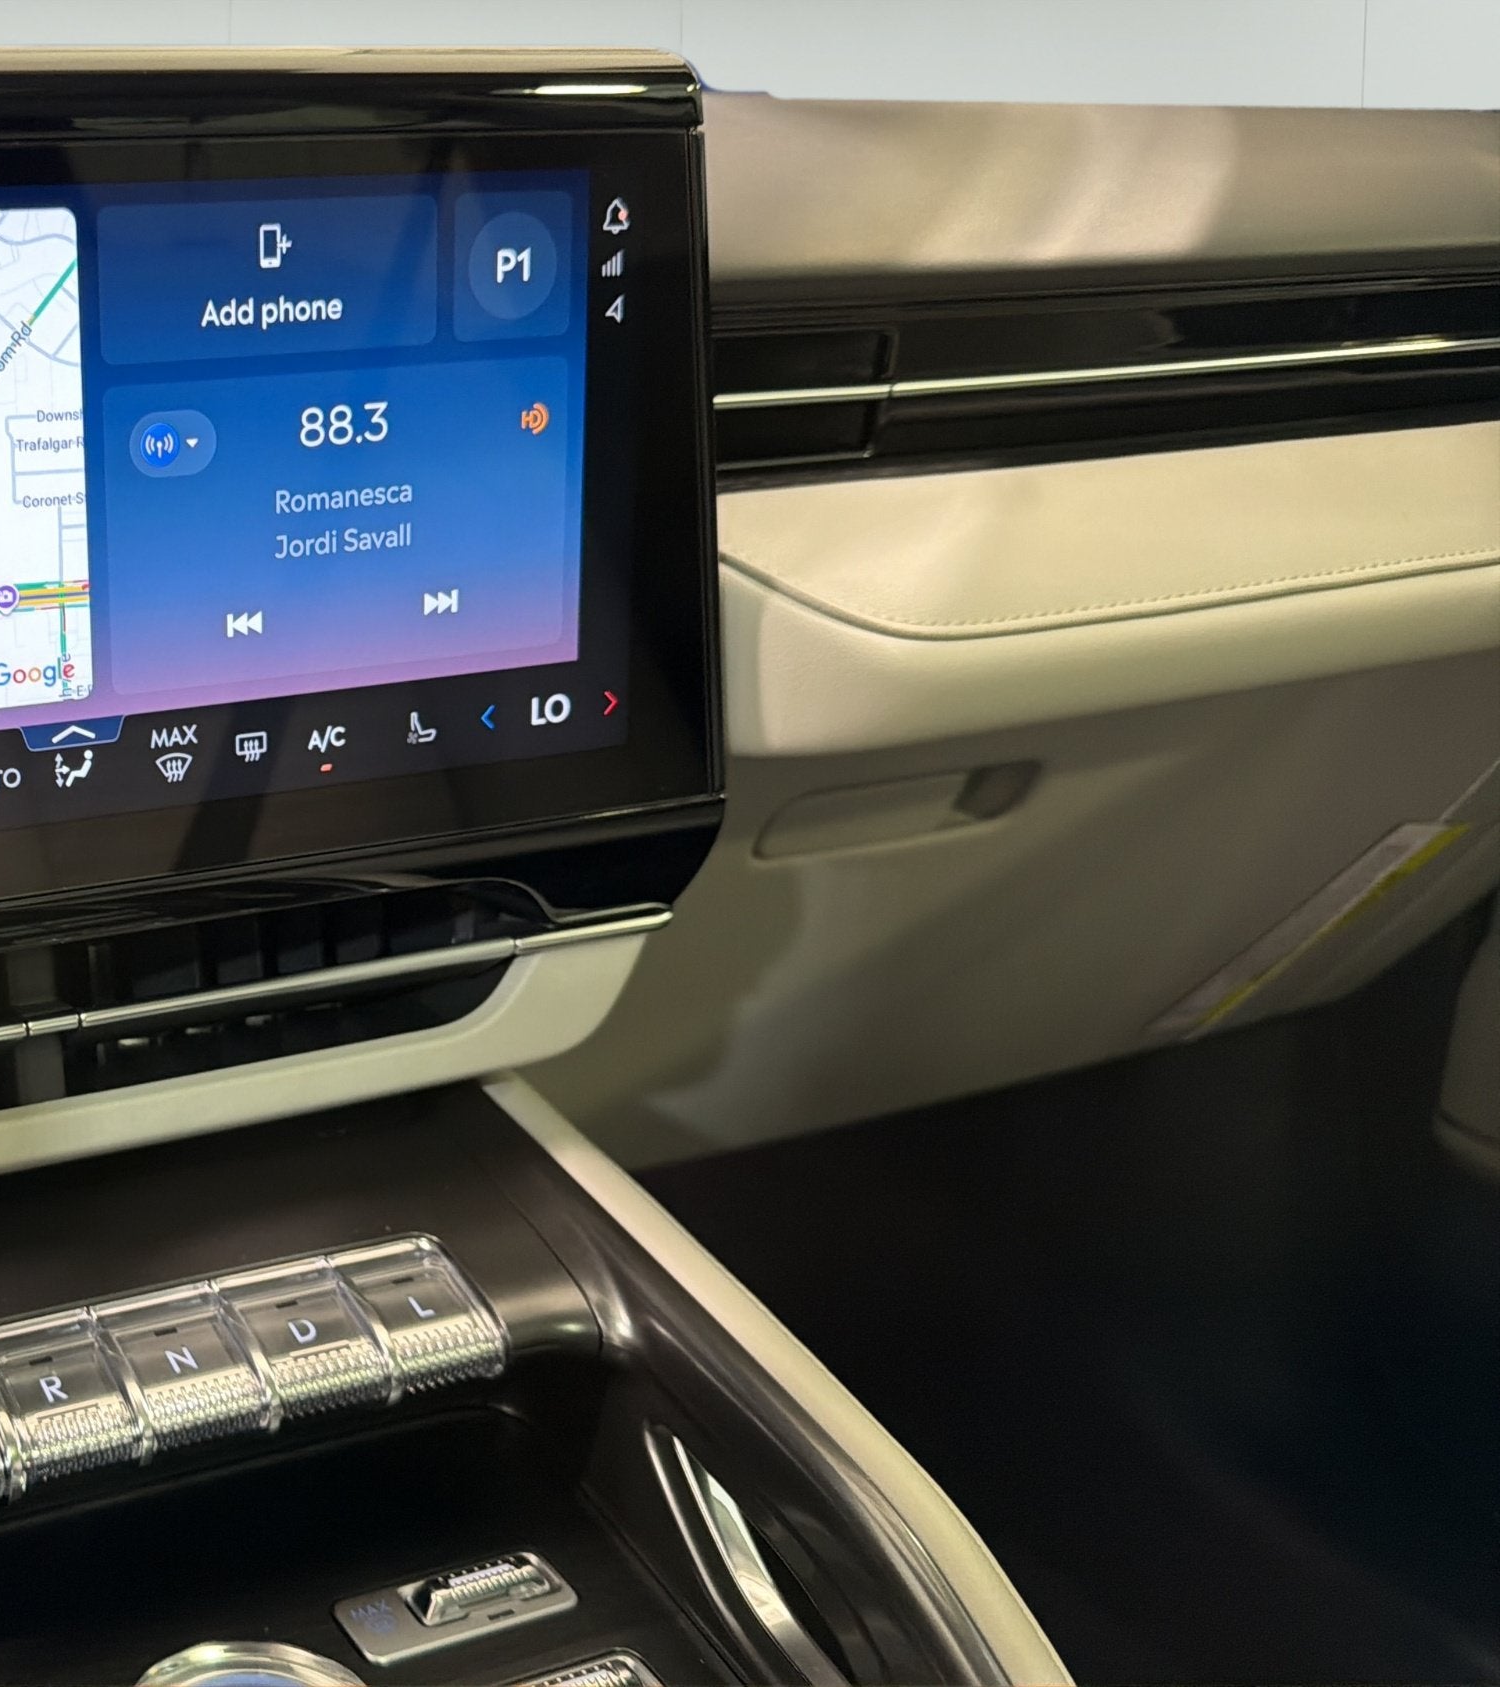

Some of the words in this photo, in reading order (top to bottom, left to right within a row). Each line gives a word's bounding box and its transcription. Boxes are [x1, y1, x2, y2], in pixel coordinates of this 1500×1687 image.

[497, 247, 532, 283] P1
[201, 297, 254, 328] Add
[261, 295, 343, 330] phone
[11, 321, 32, 347] Rd
[299, 402, 389, 447] 88.3
[16, 437, 73, 453] Trafalgar
[23, 493, 72, 508] Coronet
[275, 484, 413, 514] Romanesca
[274, 530, 337, 559] Jordi
[343, 523, 411, 551] Savall
[531, 693, 571, 726] LO
[151, 724, 198, 749] MAX
[308, 725, 346, 753] A/C
[39, 1375, 68, 1403] R
[165, 1345, 200, 1374] N
[288, 1318, 317, 1345] D
[407, 1295, 436, 1318] L
